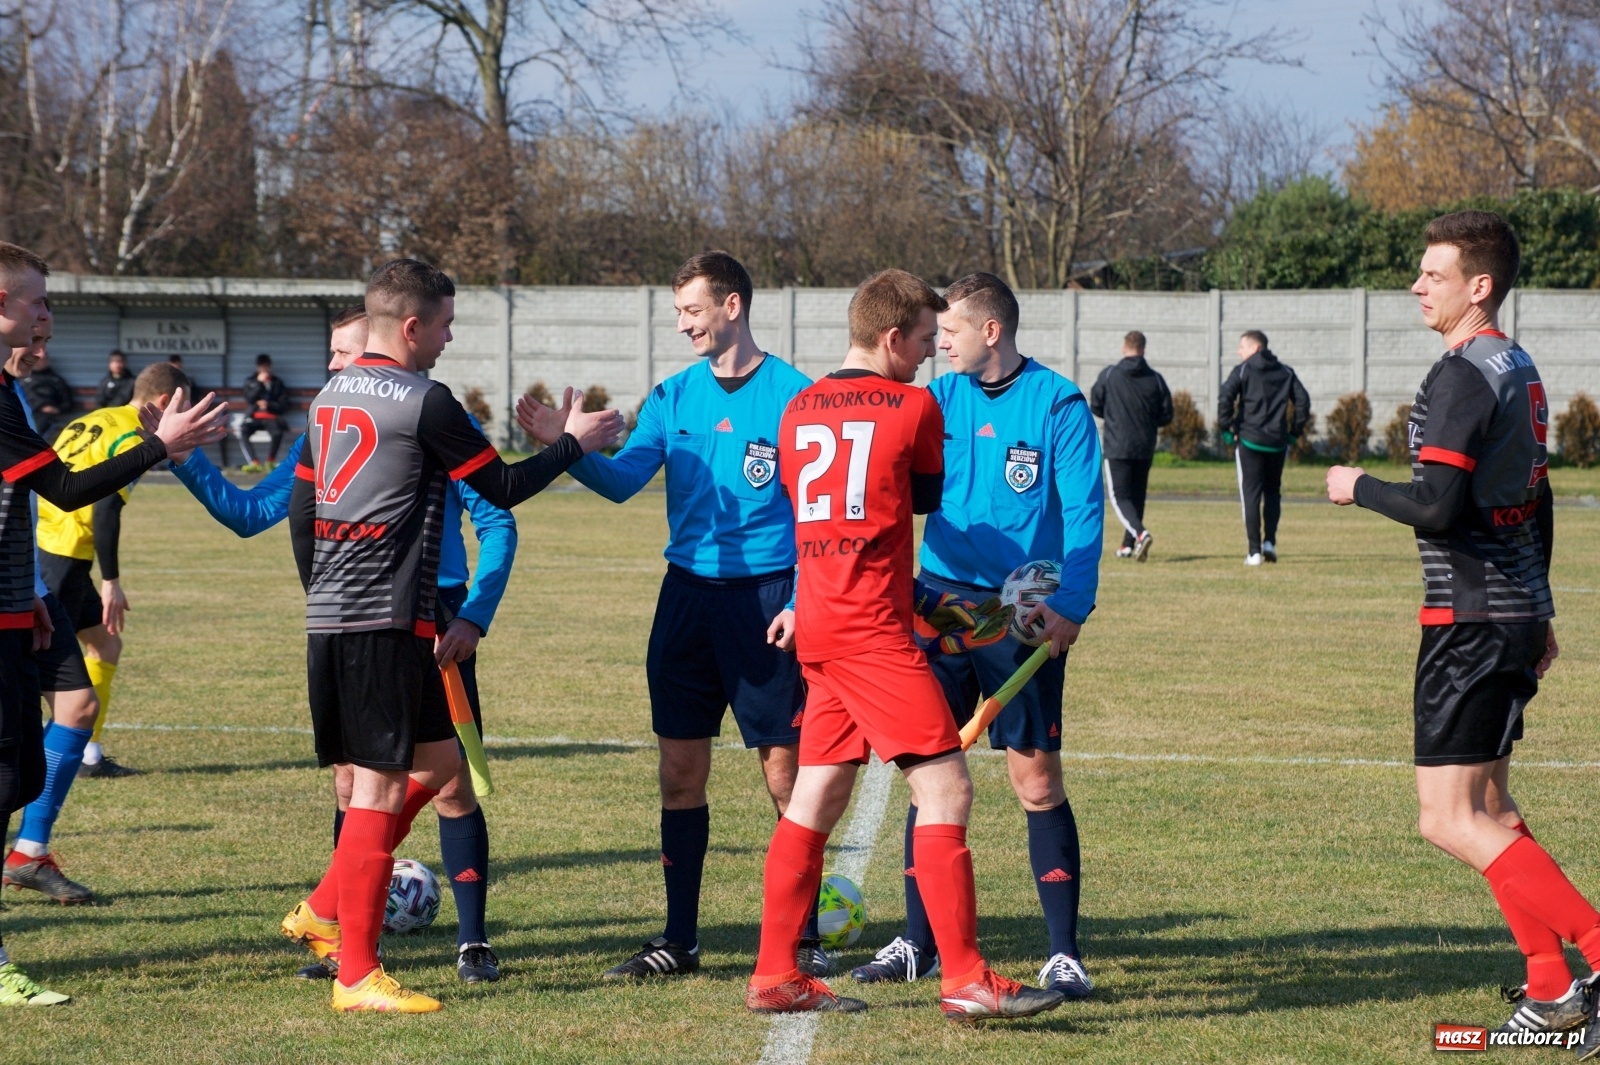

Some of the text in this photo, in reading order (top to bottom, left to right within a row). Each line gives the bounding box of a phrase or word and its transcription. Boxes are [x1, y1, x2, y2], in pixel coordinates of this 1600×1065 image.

[157, 322, 191, 335] LKS
[125, 334, 219, 351] TWORKÓW
[333, 375, 412, 402] TWORKÓW
[812, 389, 905, 410] TWORKÓW
[314, 405, 379, 505] 12
[795, 420, 877, 523] 21
